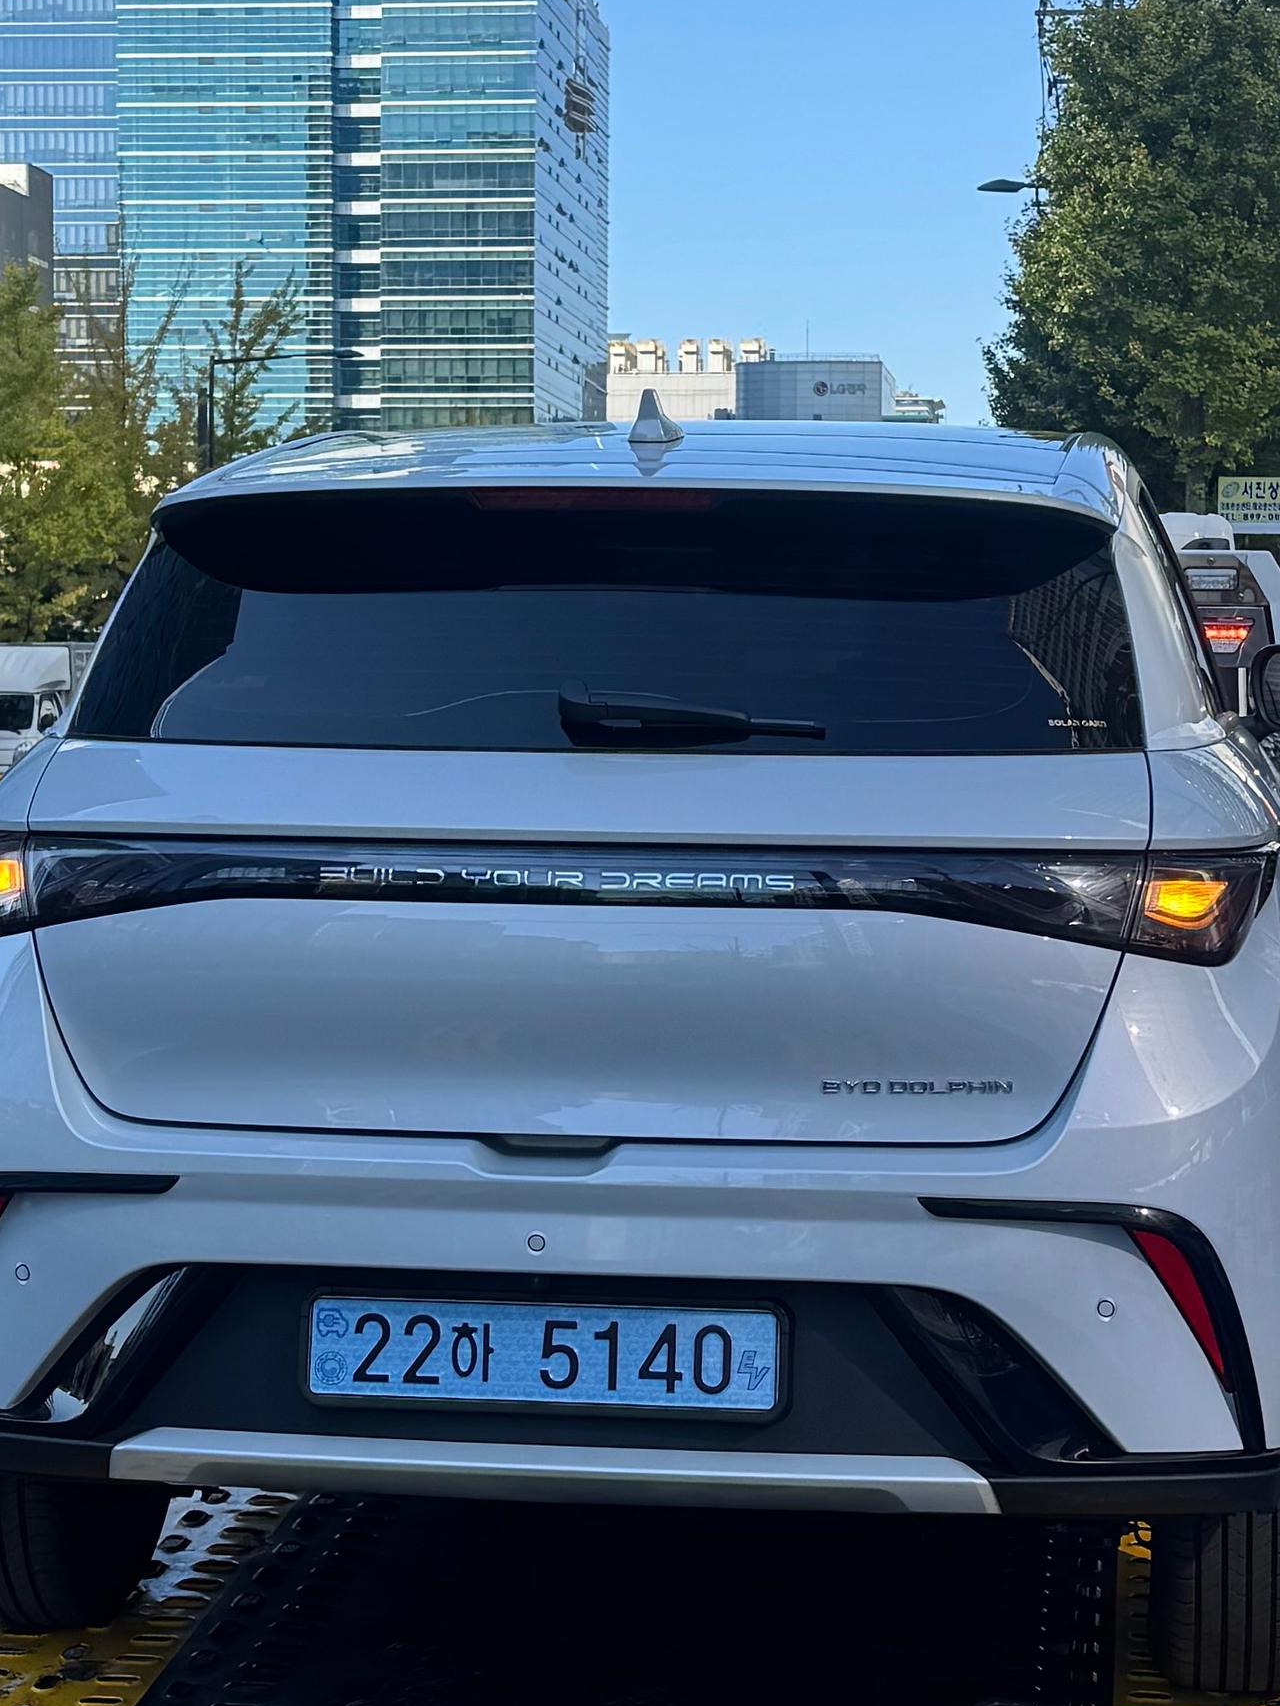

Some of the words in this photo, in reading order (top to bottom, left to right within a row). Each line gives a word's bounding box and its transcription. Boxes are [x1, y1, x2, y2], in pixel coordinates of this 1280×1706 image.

[319, 866, 445, 885] BUILD
[461, 869, 583, 887] YOUR
[601, 871, 795, 891] DREAMS
[823, 1079, 881, 1094] BYD
[889, 1079, 1013, 1095] DOLPHIN
[352, 1312, 495, 1385] 22하
[539, 1319, 732, 1395] 5140
